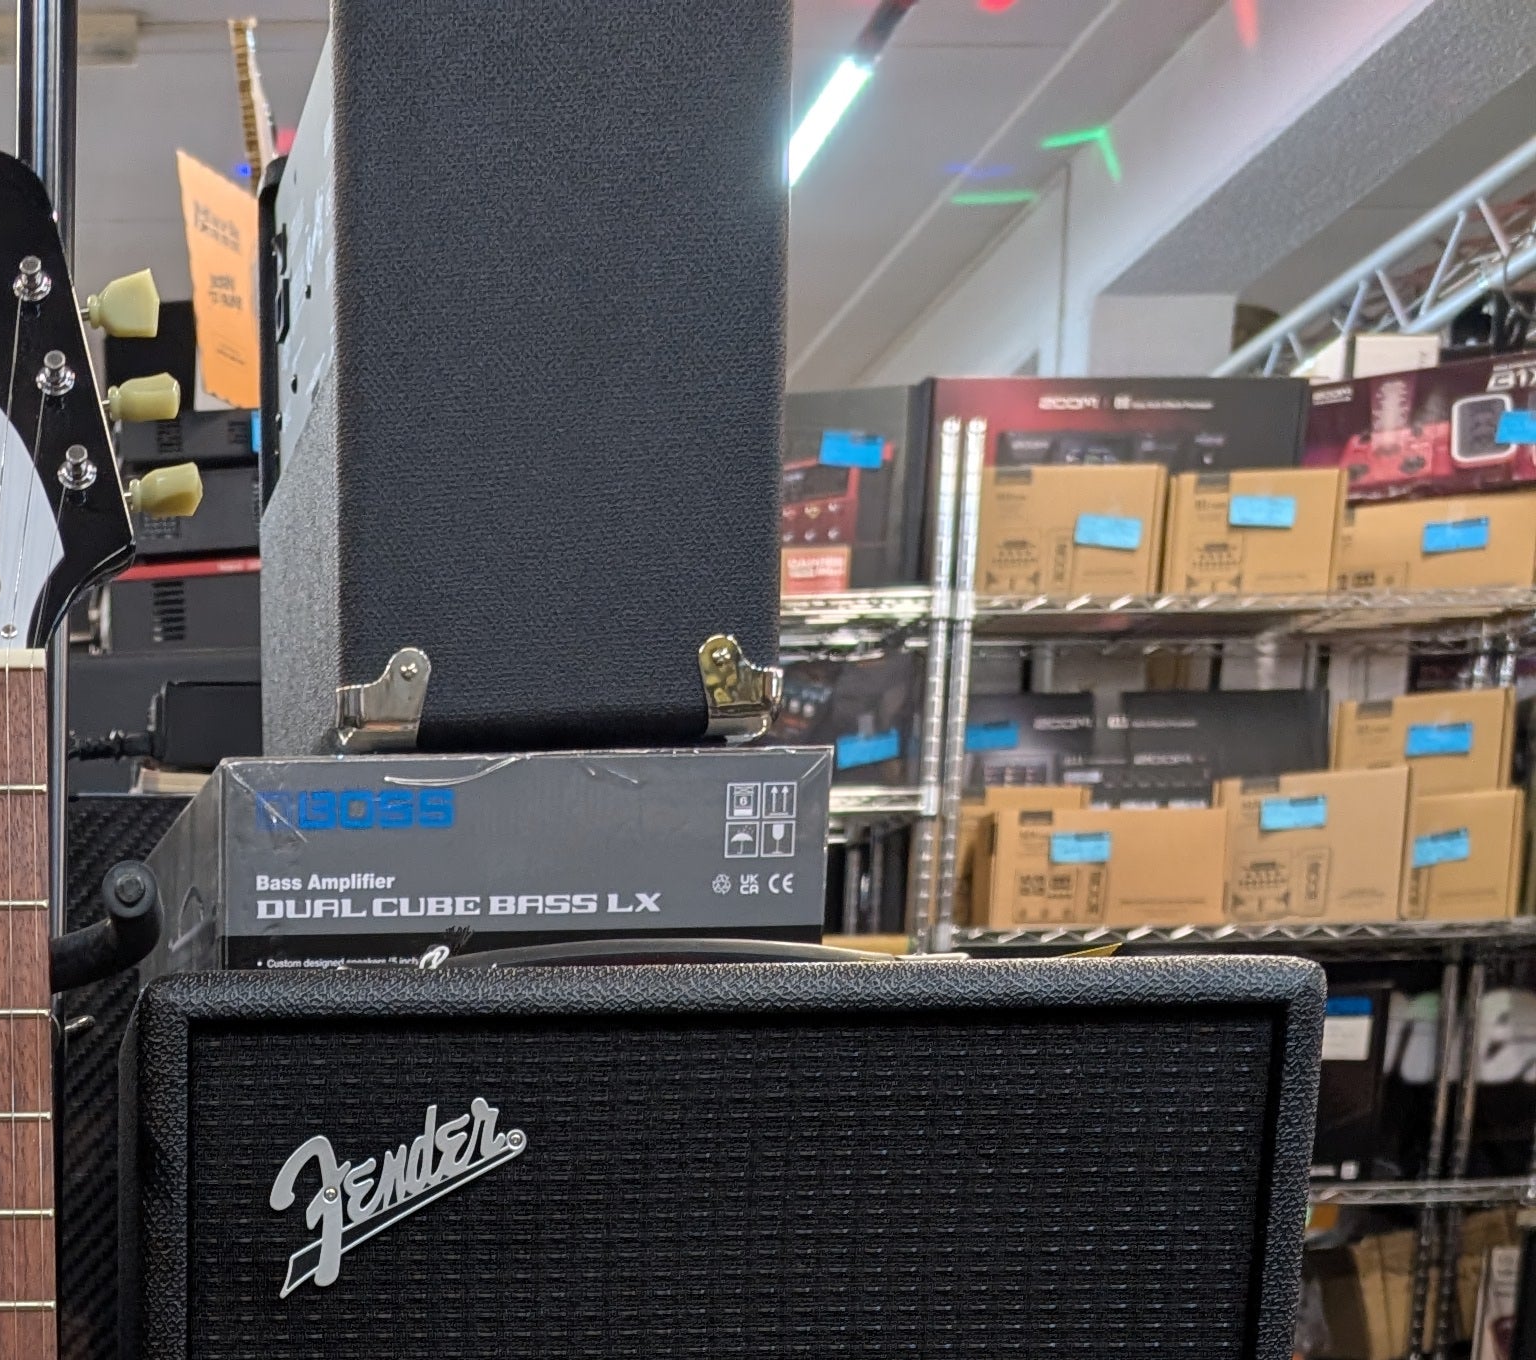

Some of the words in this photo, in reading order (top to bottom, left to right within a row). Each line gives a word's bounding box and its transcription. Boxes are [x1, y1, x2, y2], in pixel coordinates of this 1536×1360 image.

[257, 788, 456, 831] BOSS
[256, 875, 302, 891] Bass
[308, 873, 396, 893] Amplifier
[768, 872, 794, 894] CE
[256, 898, 367, 919] DUAL
[372, 896, 480, 917] CUBE
[488, 894, 598, 916] BASS
[607, 893, 662, 913] LX
[266, 959, 302, 968] Custom
[269, 1097, 526, 1298] Fender
